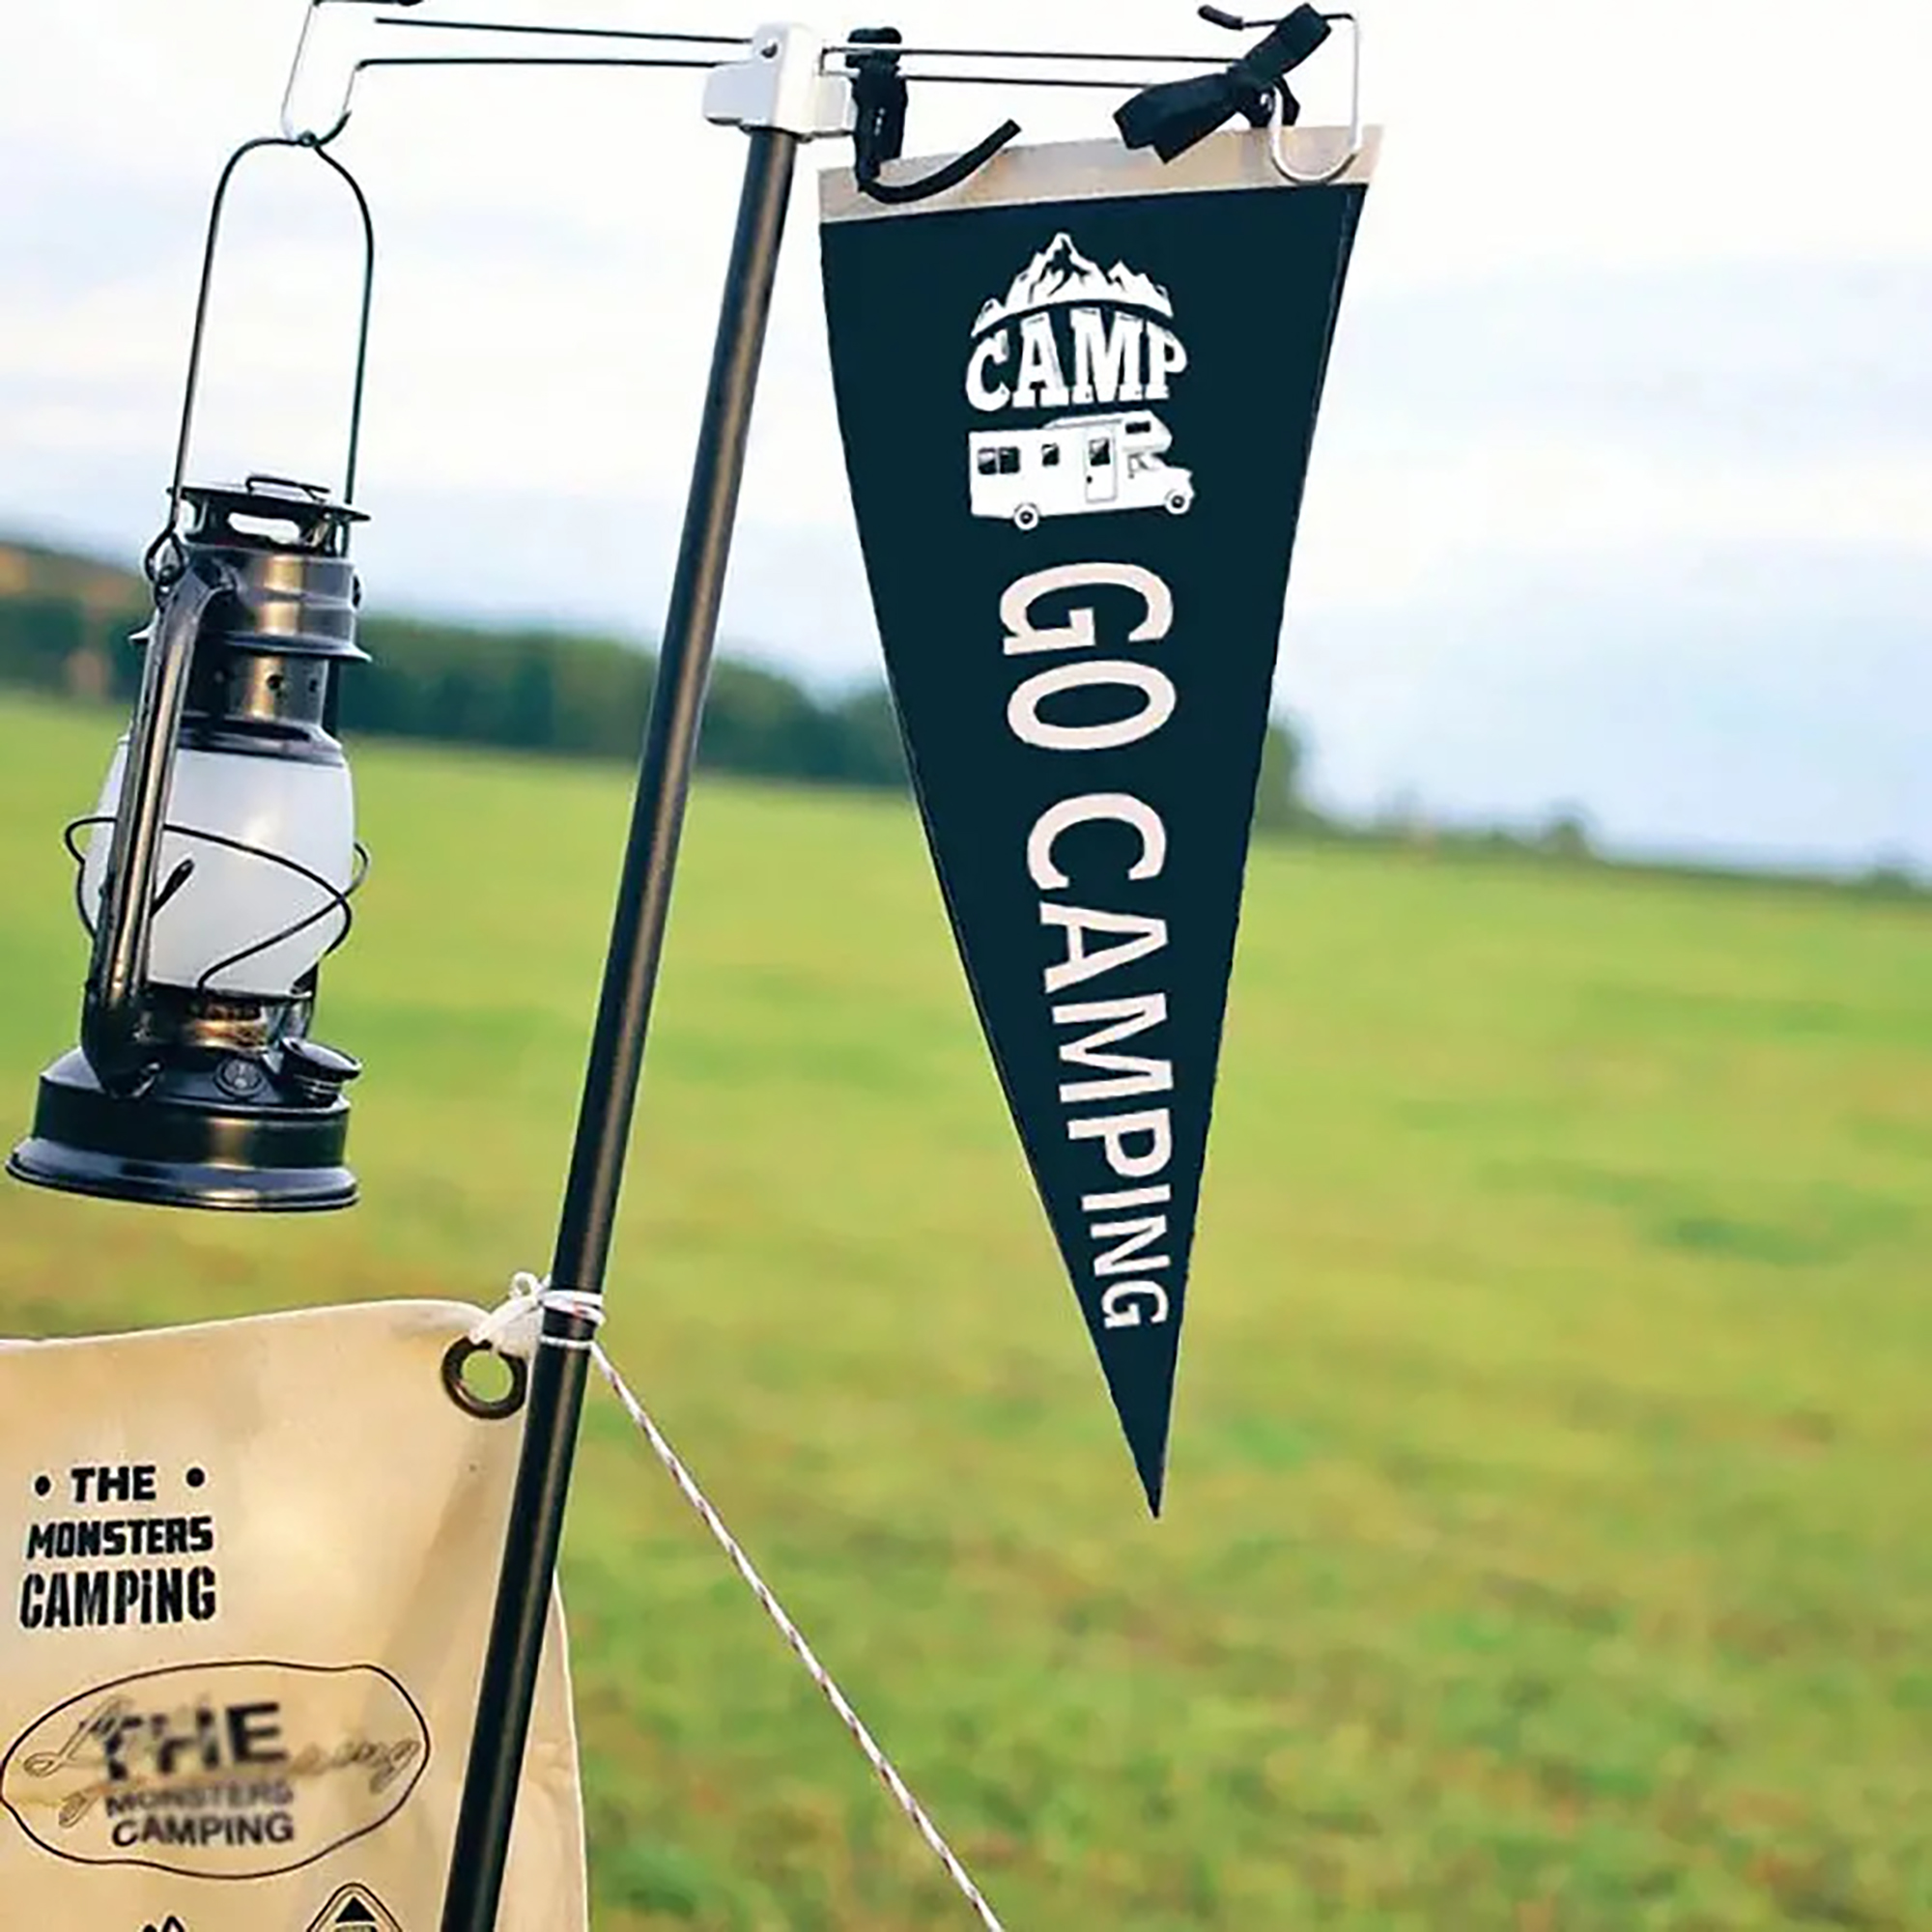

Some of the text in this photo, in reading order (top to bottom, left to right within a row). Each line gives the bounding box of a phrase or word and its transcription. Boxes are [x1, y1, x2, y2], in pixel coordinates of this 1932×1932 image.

[965, 306, 1188, 412] CAMP
[999, 561, 1177, 1329] GO CAMPING
[71, 1464, 157, 1503] THE
[26, 1515, 214, 1560] MONSTERS
[111, 1812, 295, 1847] CAMPING
